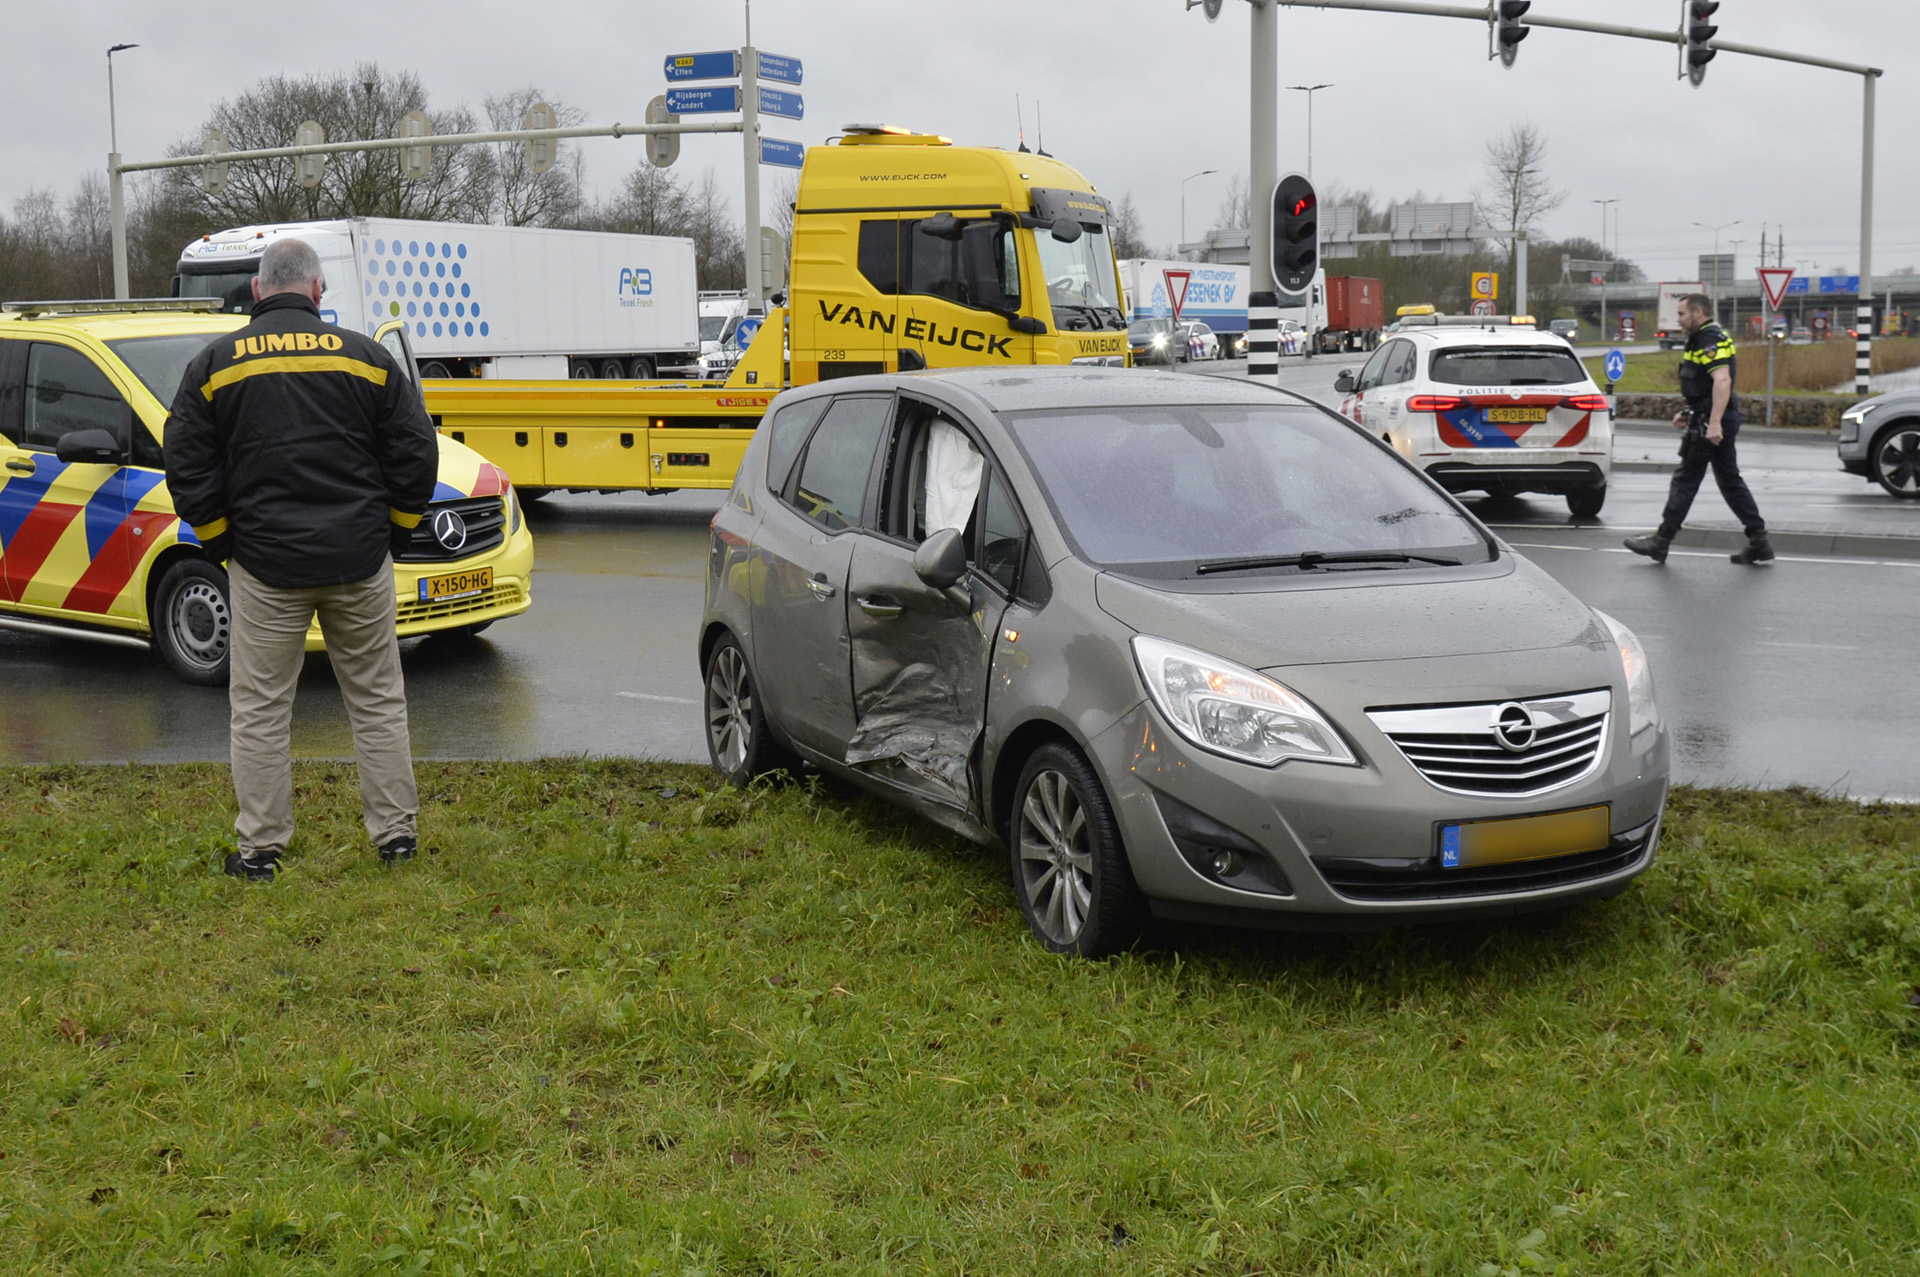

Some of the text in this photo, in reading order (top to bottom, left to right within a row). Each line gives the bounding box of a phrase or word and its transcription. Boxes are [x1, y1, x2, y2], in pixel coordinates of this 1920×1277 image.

[676, 58, 692, 66] N263
[760, 65, 783, 76] Rotterdam
[675, 91, 712, 101] Rijsbergen
[761, 91, 778, 100] Utrecht
[676, 101, 704, 110] Zundert
[761, 100, 777, 112] Tilburg
[762, 141, 786, 151] Antwerpen
[859, 173, 947, 182] WWW.EIJCK.COM
[221, 243, 249, 251] Texel
[1224, 284, 1237, 303] BV
[619, 298, 653, 308] Texel Fresh
[818, 300, 1014, 358] VAN EIJCK
[232, 333, 343, 360] JUMBO
[1079, 339, 1121, 353] VAN EIJCK
[824, 350, 846, 360] 239
[1491, 409, 1543, 420] S-908-HL
[432, 571, 488, 595] X-150-HG
[1444, 850, 1457, 860] NL
